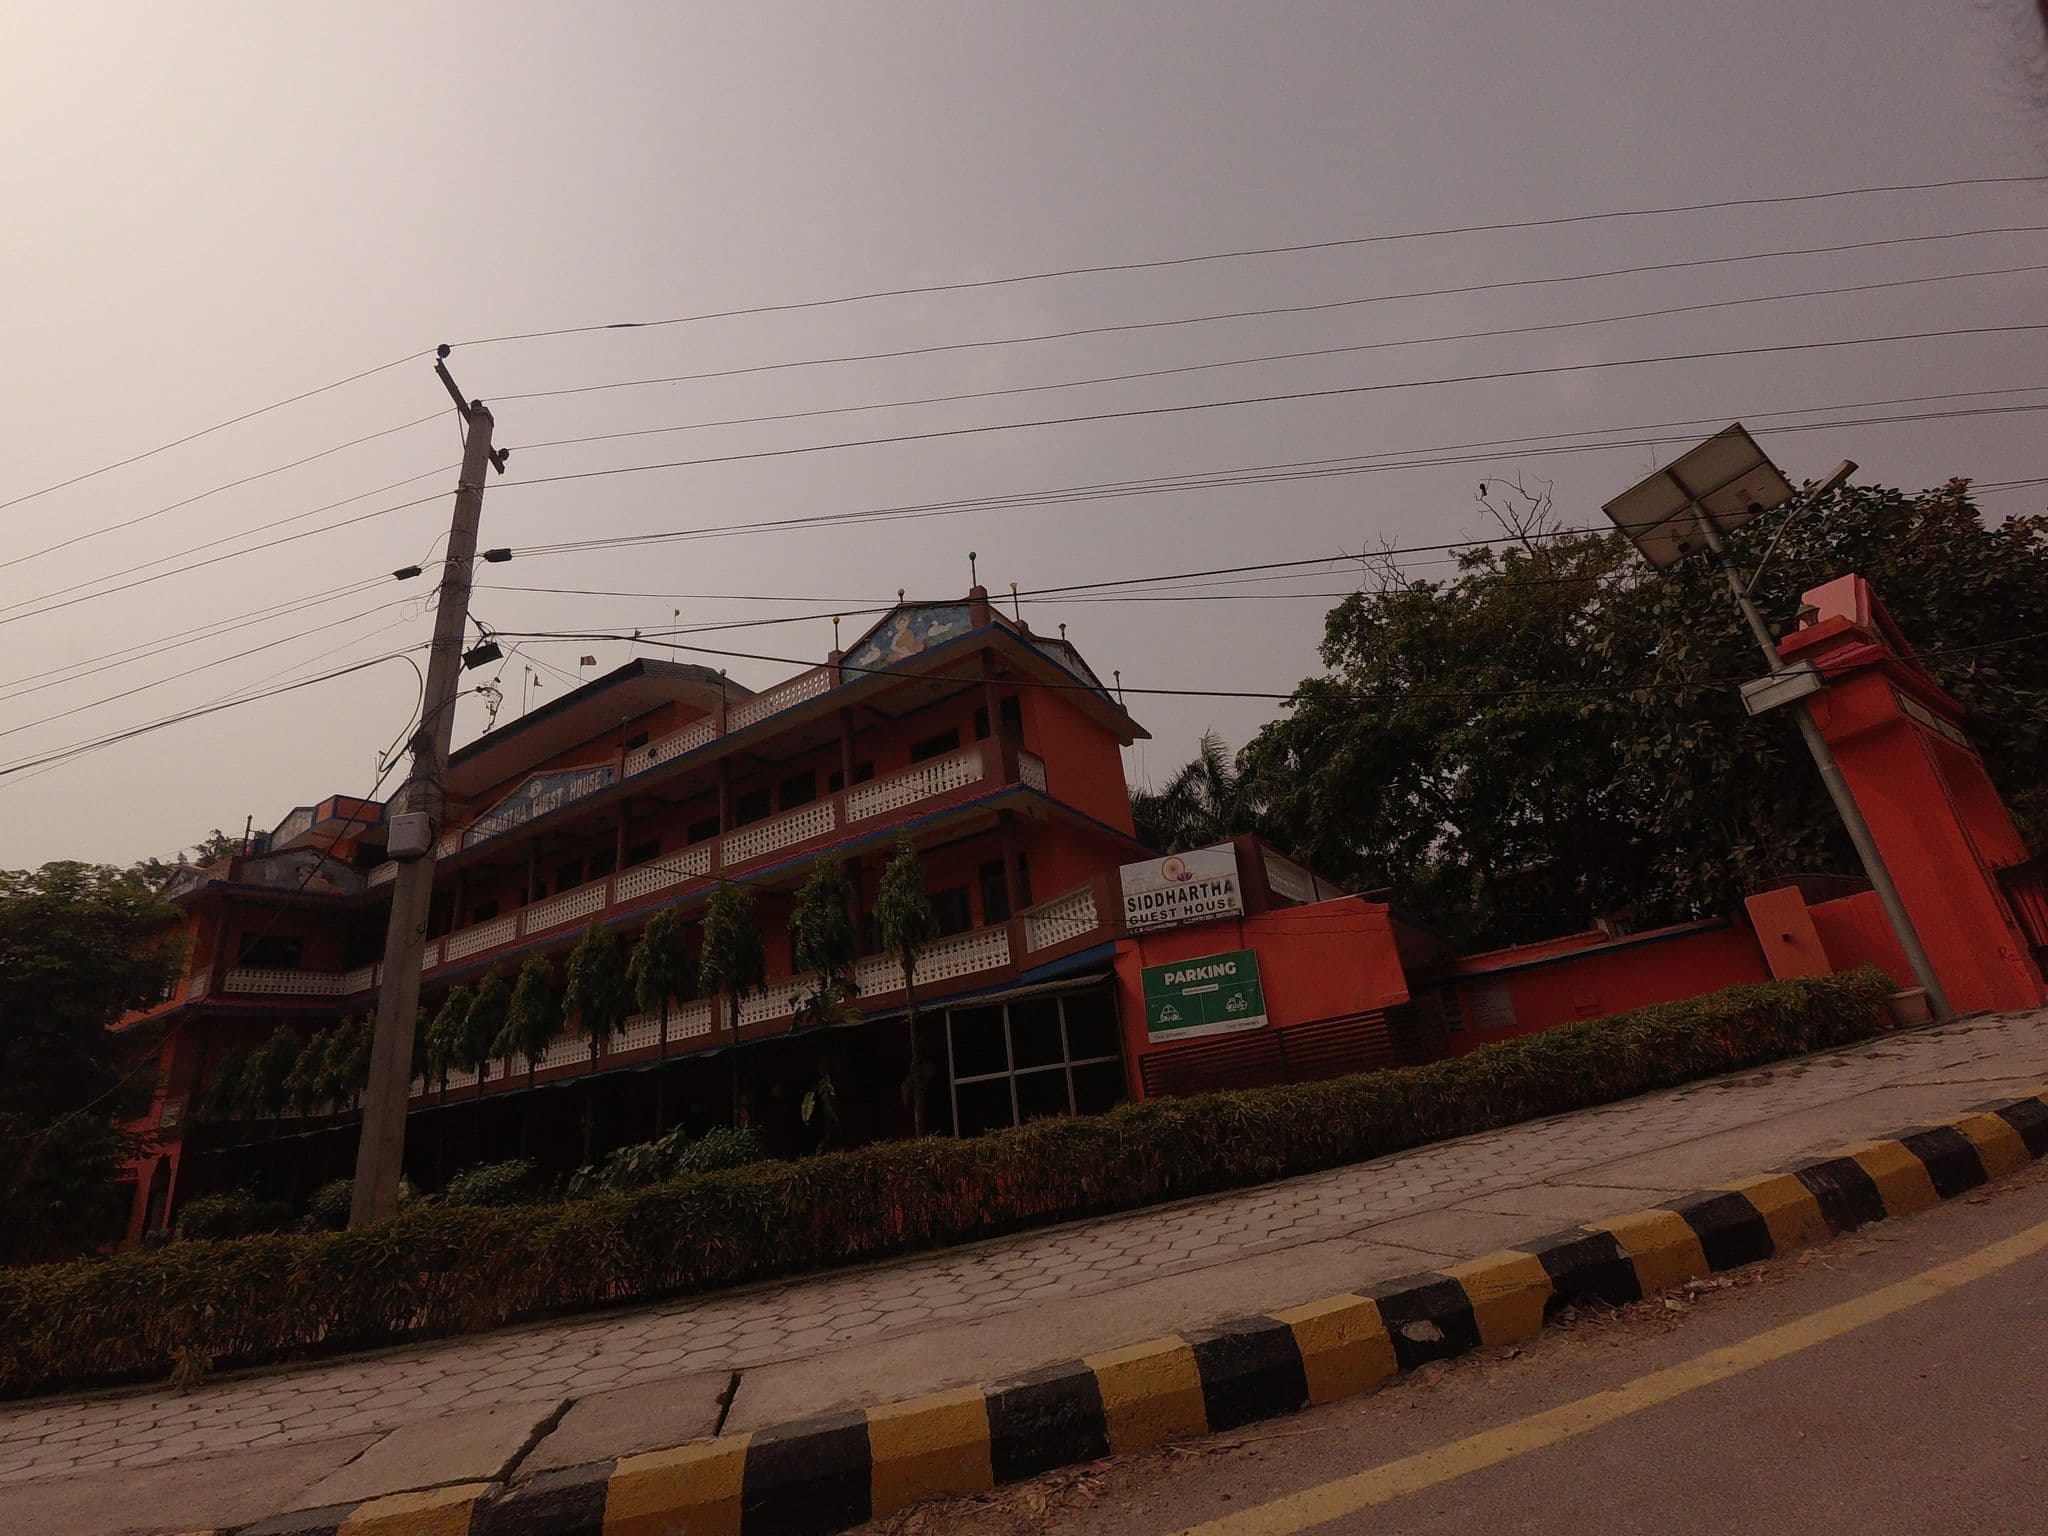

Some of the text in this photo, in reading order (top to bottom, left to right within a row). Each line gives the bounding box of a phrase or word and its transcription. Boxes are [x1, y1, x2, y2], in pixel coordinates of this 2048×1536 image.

[532, 788, 564, 818] GUEST
[569, 770, 602, 801] HOUSE
[1127, 879, 1234, 913] SIDDHARTHA
[1129, 908, 1177, 926] GUEST
[1184, 898, 1236, 916] HOUSE
[1164, 961, 1237, 986] PARKING
